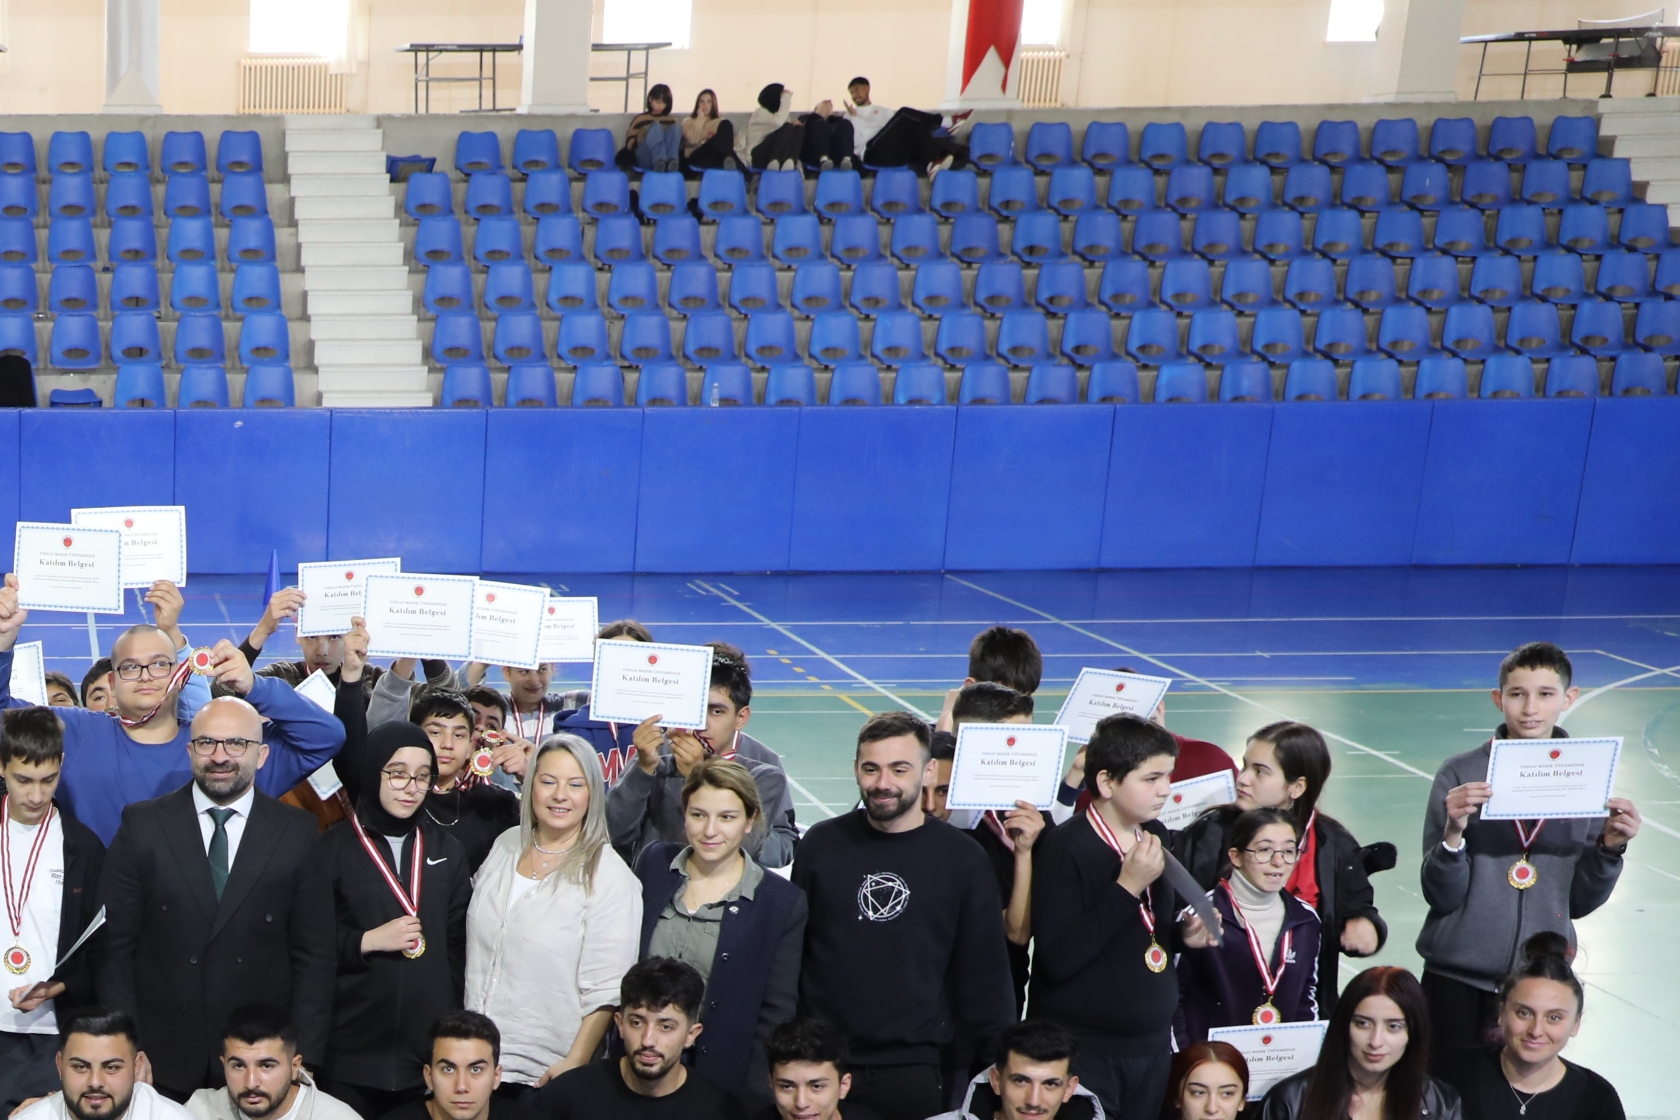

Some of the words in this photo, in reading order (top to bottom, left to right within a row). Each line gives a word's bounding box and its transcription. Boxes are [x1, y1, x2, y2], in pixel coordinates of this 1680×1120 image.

[131, 539, 157, 547] Belgesi
[39, 559, 66, 567] Katılım
[68, 560, 94, 568] Belgesi
[389, 607, 417, 615] Katılım
[419, 609, 446, 617] Belgesi
[489, 615, 516, 624] Belgesi
[622, 674, 650, 682] Katılım
[652, 677, 679, 685] Belgesi
[1089, 699, 1111, 708] Katılım
[1112, 702, 1134, 711] Belgesi
[1009, 759, 1036, 767] Belgesi
